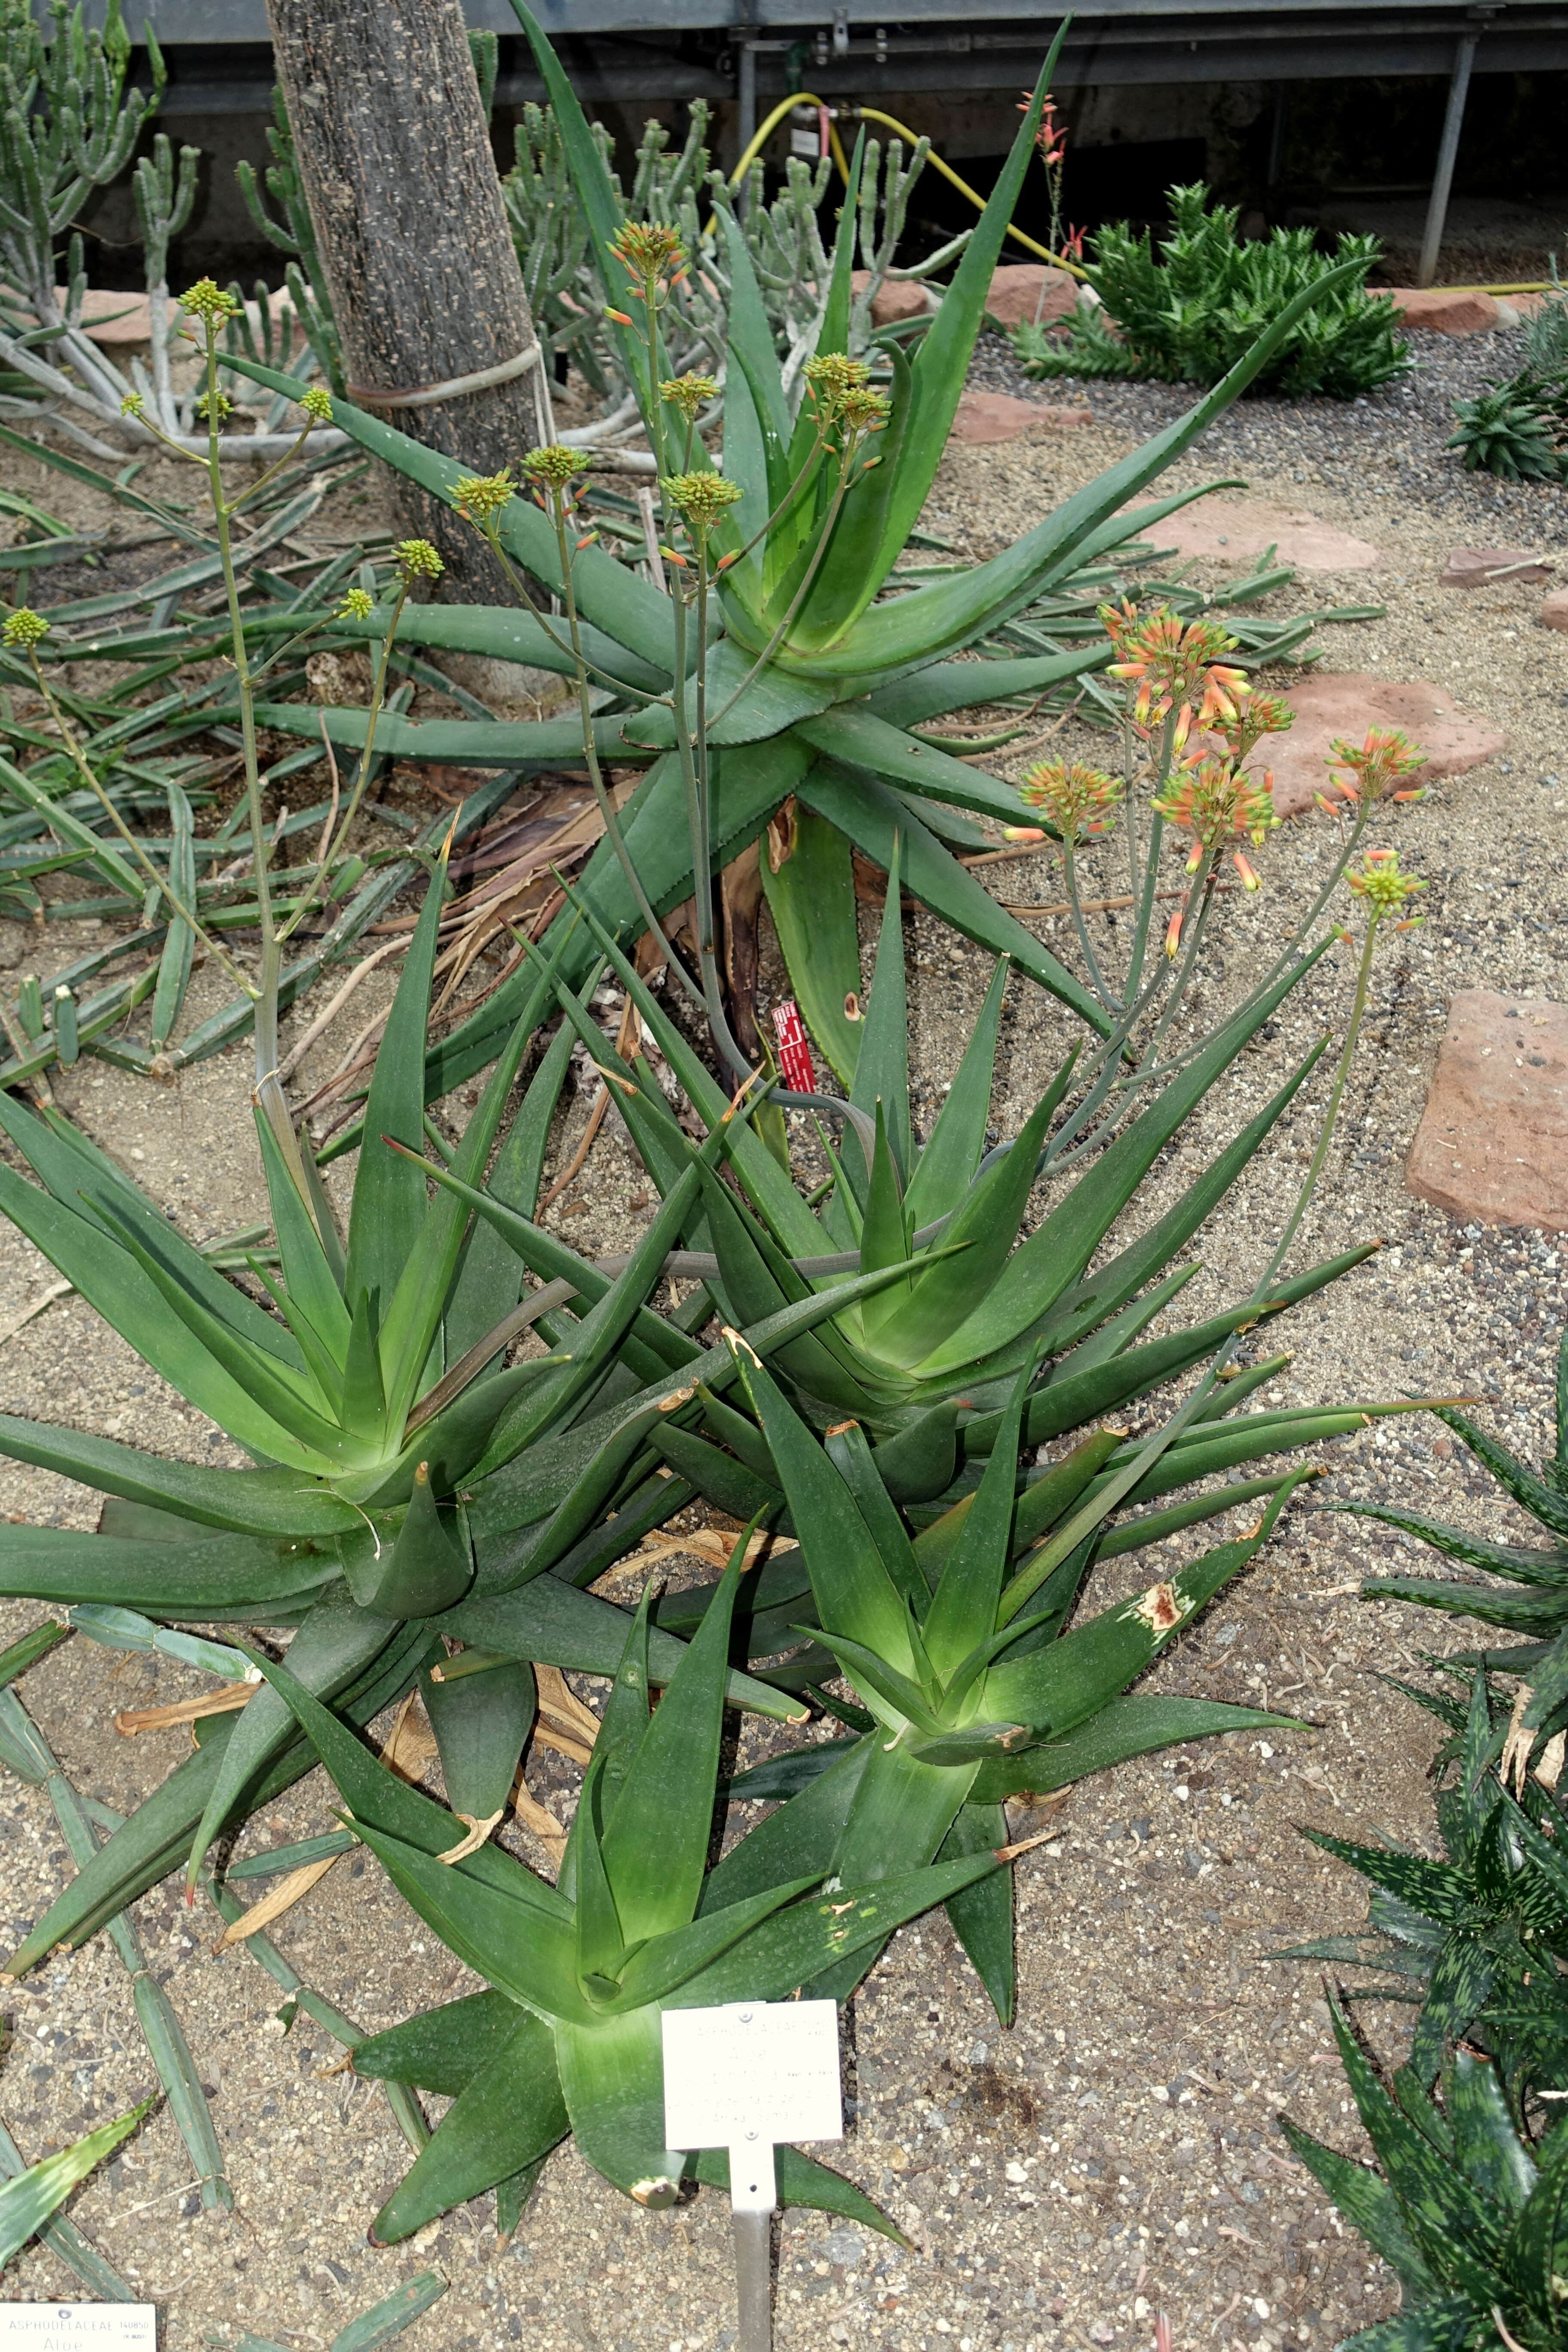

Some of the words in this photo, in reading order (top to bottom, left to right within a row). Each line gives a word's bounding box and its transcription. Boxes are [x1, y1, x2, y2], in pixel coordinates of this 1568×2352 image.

[697, 2021, 797, 2038] ASPHODELACEAE
[729, 2047, 766, 2062] Aloe
[9, 2320, 113, 2331] ASPHODELACEAE
[43, 2337, 83, 2352] Aloe
